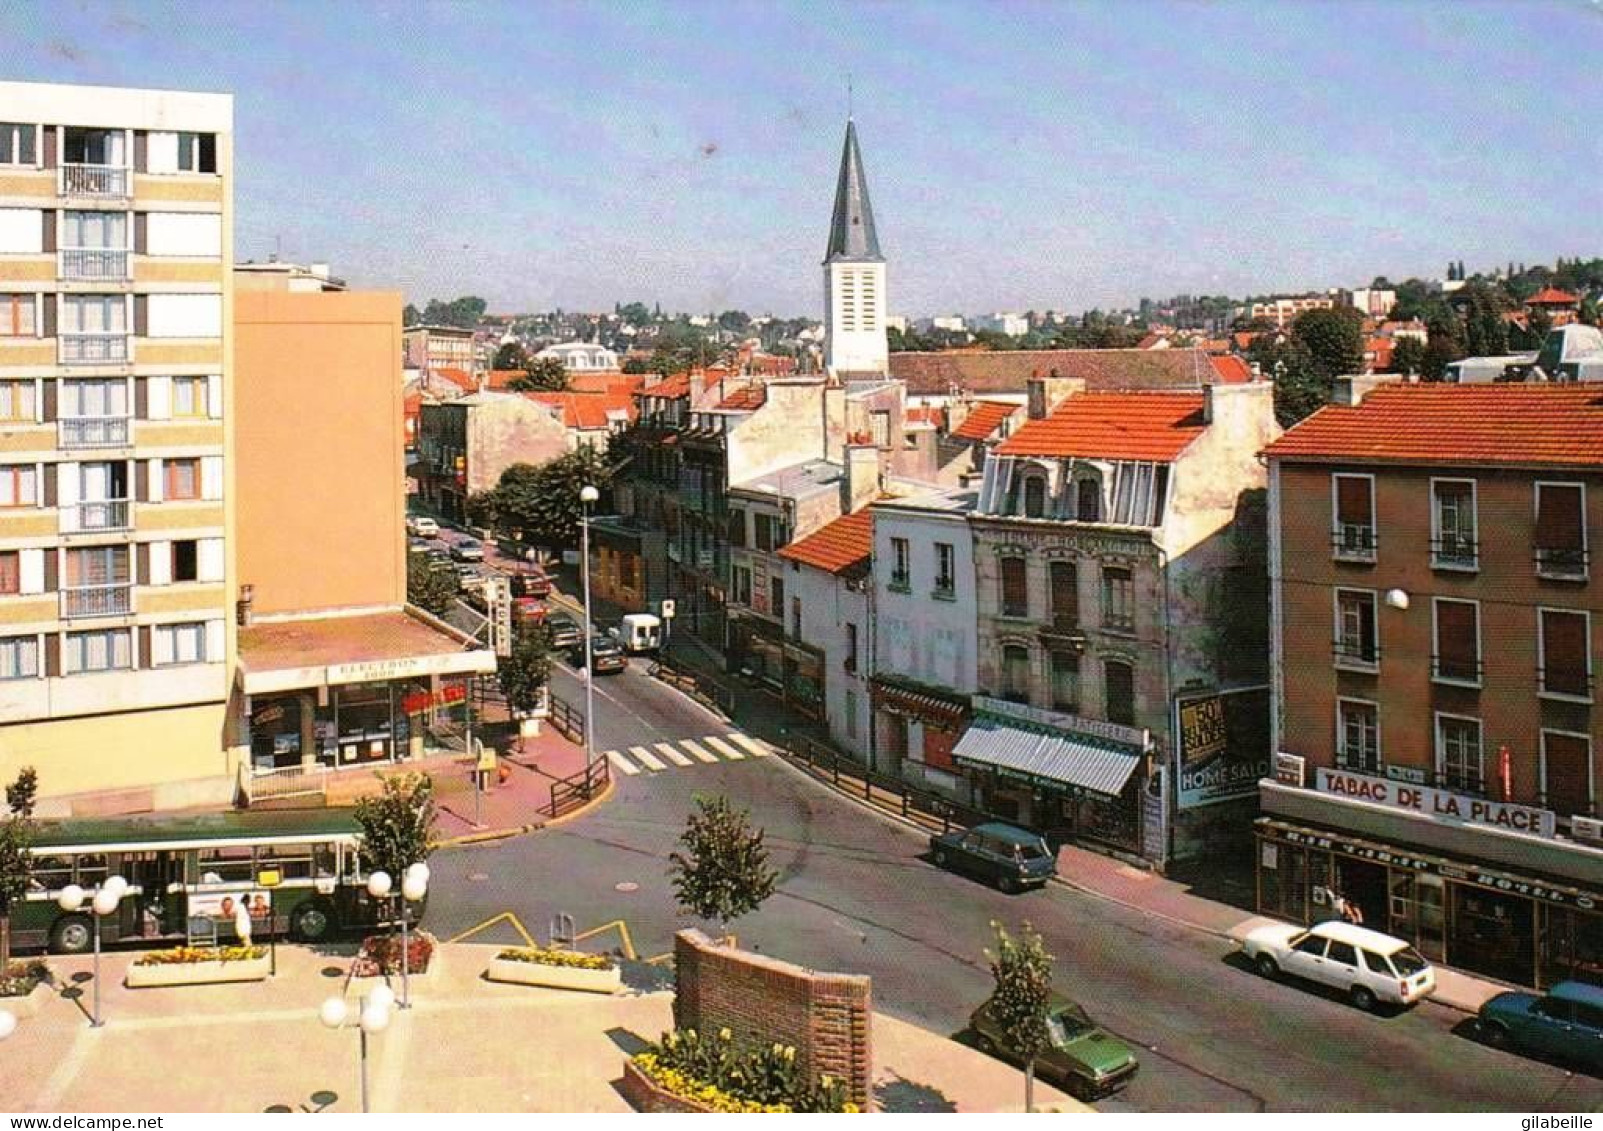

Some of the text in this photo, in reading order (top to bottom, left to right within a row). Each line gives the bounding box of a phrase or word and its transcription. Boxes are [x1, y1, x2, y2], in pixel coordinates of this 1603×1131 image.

[1182, 767, 1228, 790] HOME
[1324, 773, 1388, 801] TABAC
[1397, 788, 1423, 809] DE
[1433, 793, 1461, 816] LA
[1470, 801, 1541, 833] PLACE
